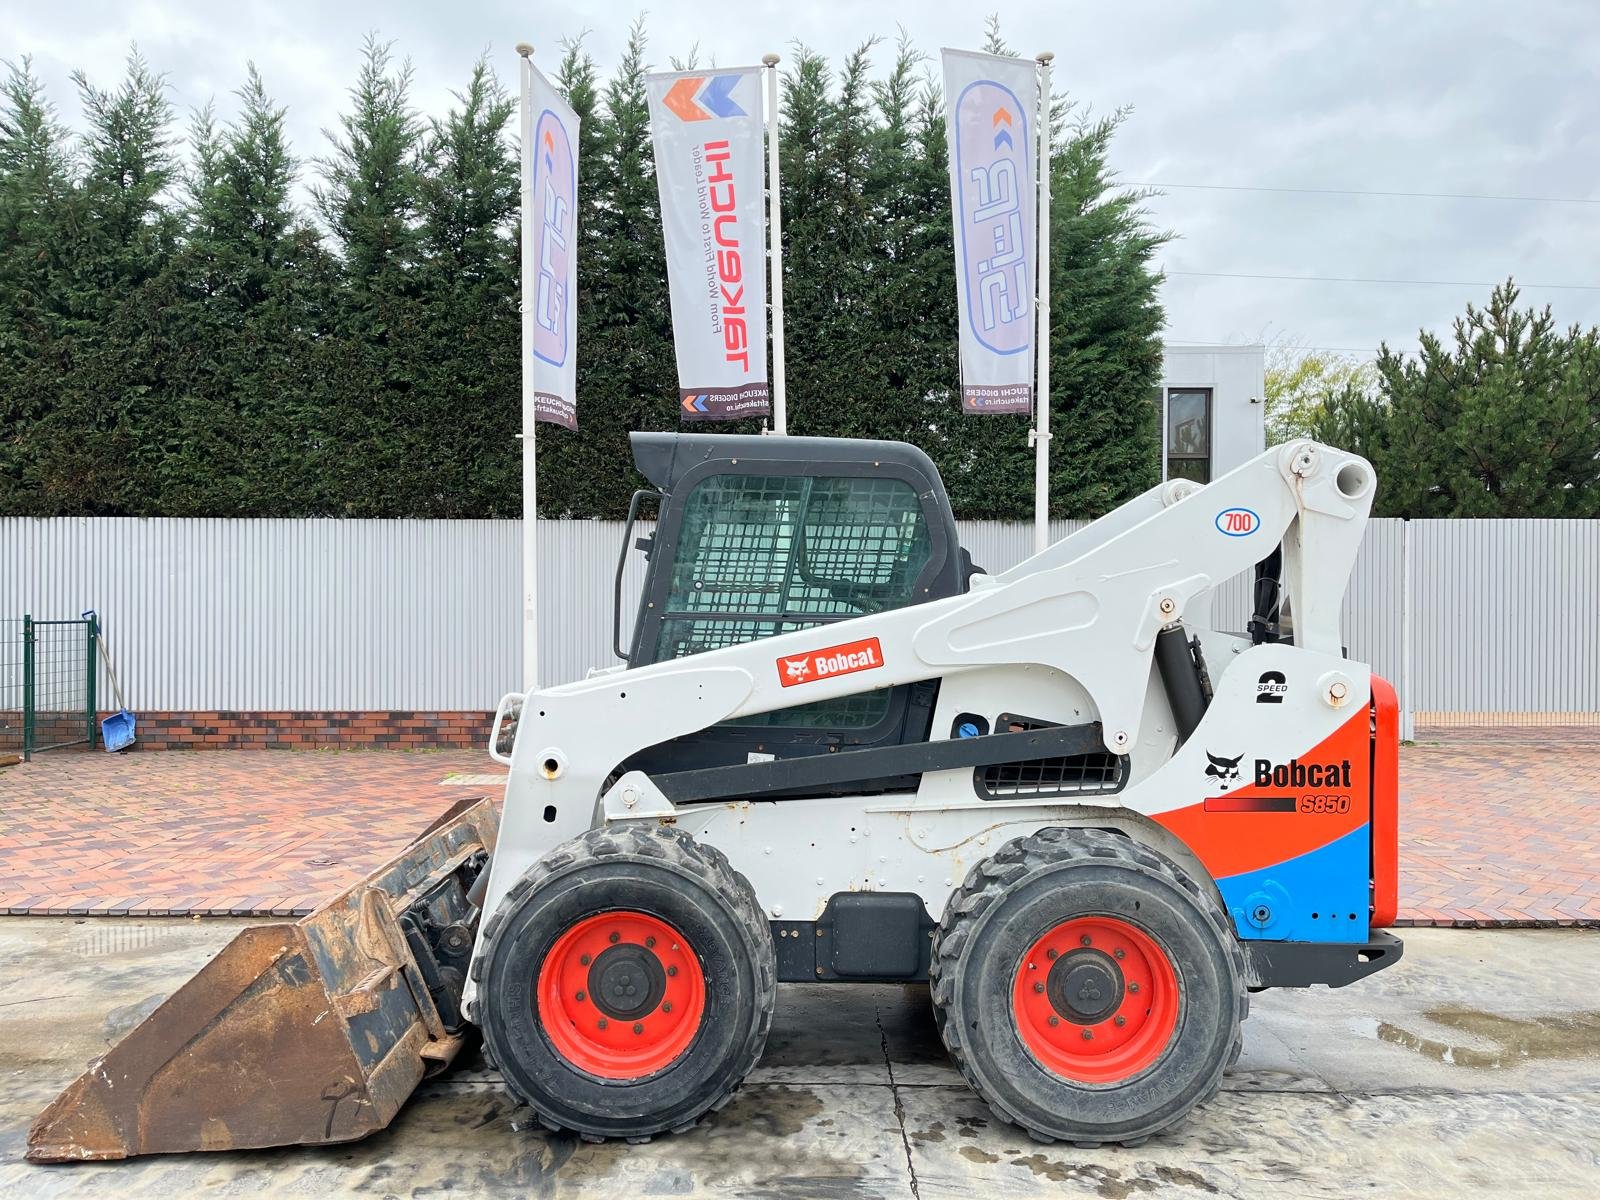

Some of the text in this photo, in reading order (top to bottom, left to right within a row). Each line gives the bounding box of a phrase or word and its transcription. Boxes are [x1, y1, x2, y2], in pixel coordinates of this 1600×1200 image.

[1225, 513, 1252, 531] 700
[815, 647, 876, 676] Bobcat
[1256, 671, 1286, 703] 2
[1257, 684, 1288, 692] SPEED
[1255, 759, 1351, 788] Bobcat
[1301, 795, 1351, 814] S850
